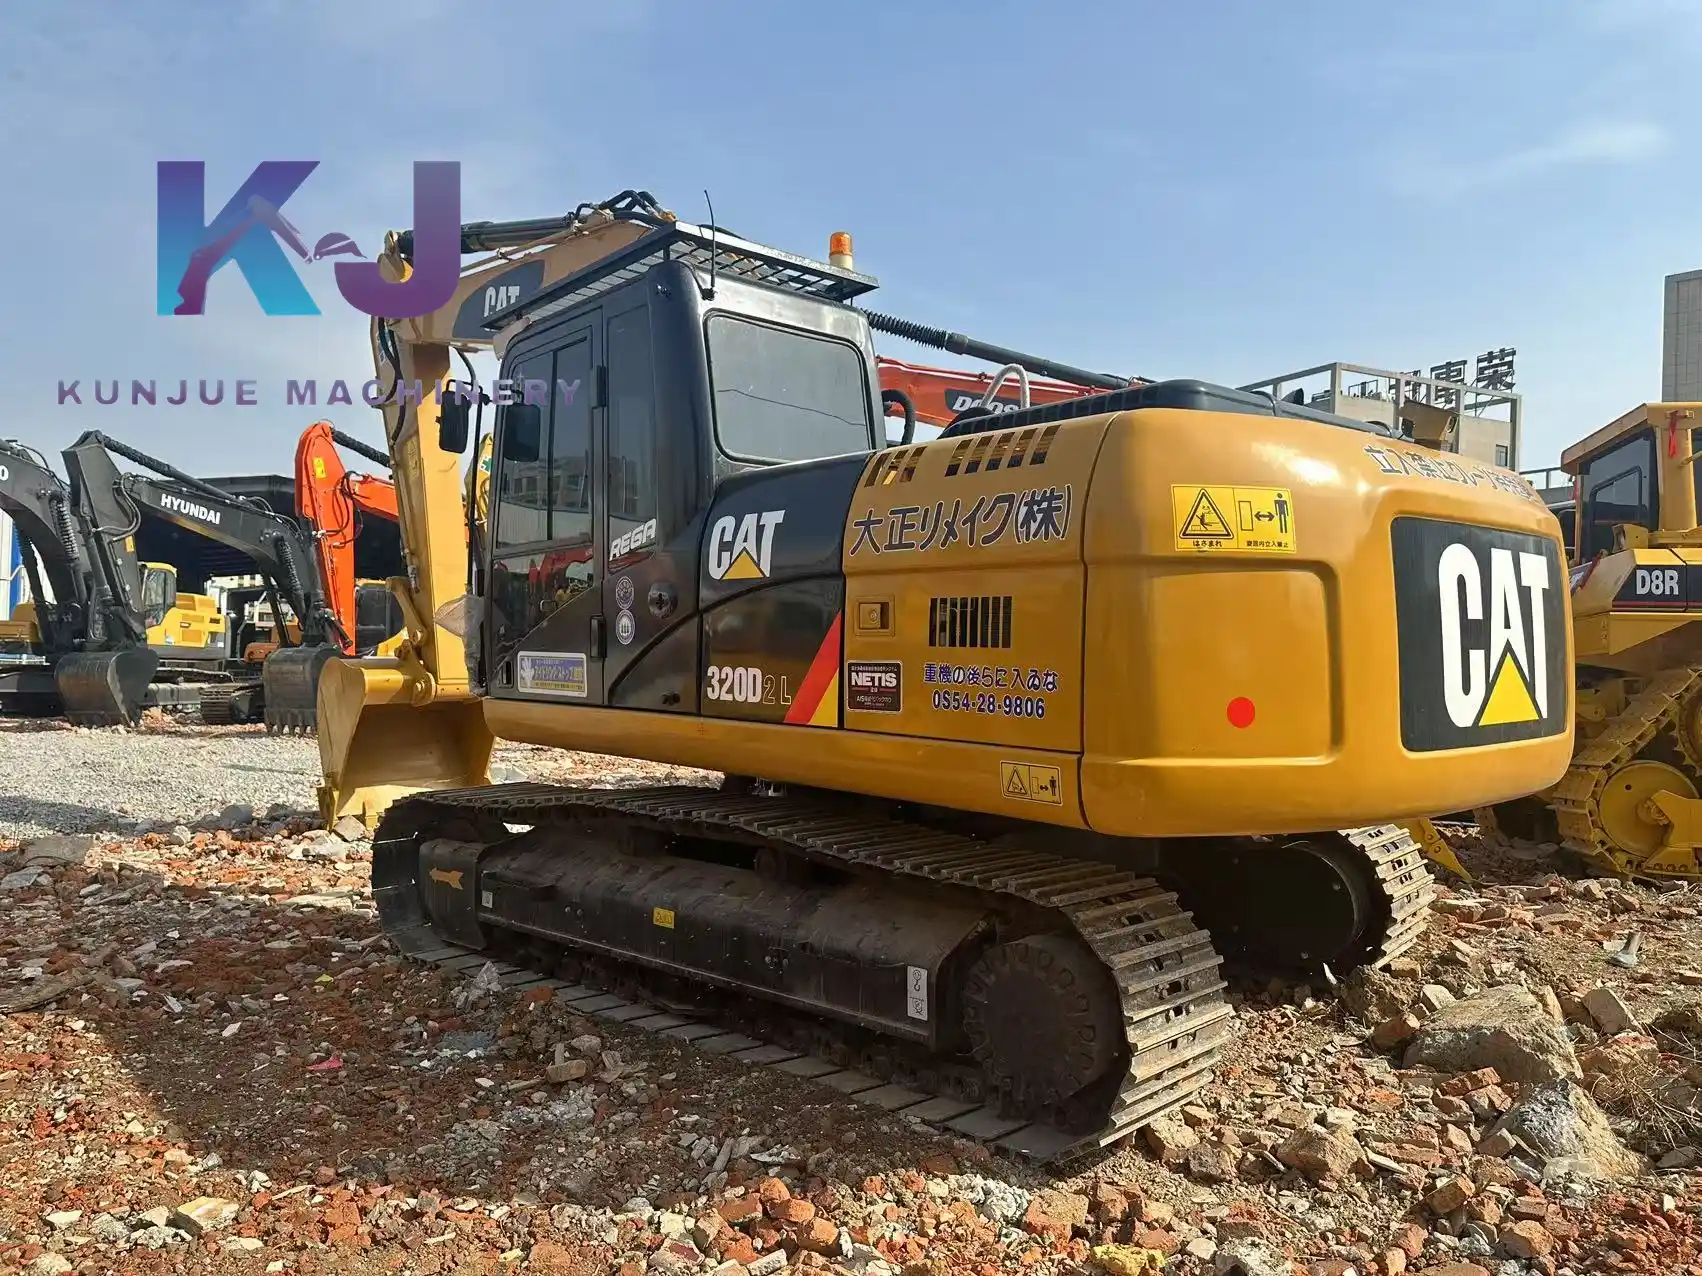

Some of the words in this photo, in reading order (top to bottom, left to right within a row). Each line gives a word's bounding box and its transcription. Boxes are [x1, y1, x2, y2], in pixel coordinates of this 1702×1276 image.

[160, 493, 221, 525] HYUNDAI
[609, 518, 657, 562] REGA
[708, 509, 786, 580] CAT
[1635, 569, 1680, 596] D8R
[1437, 543, 1550, 729] CAT
[851, 672, 897, 688] NETIS
